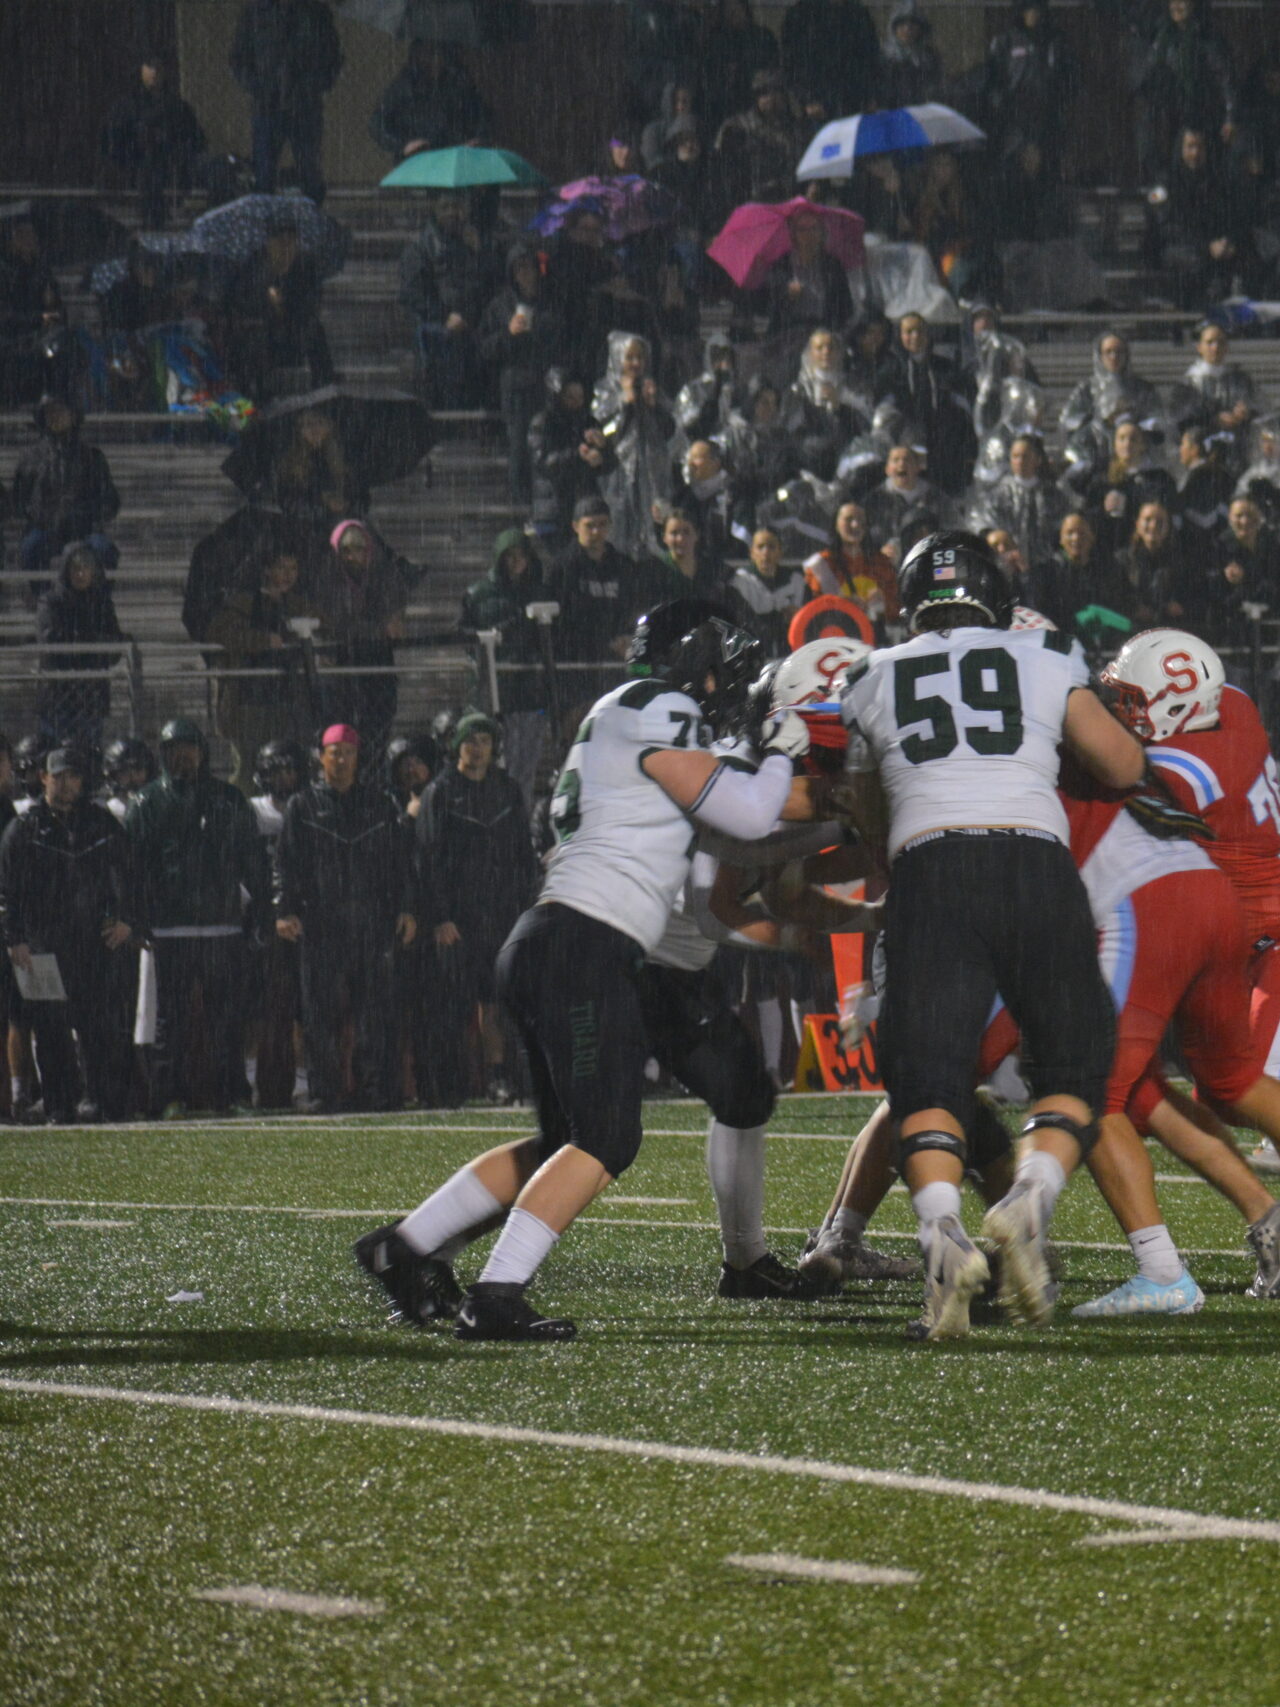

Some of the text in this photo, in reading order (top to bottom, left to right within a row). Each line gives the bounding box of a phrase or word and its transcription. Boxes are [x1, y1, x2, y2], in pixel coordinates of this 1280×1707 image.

[932, 549, 956, 567] 59
[1161, 652, 1199, 695] S
[894, 647, 1024, 765] 59
